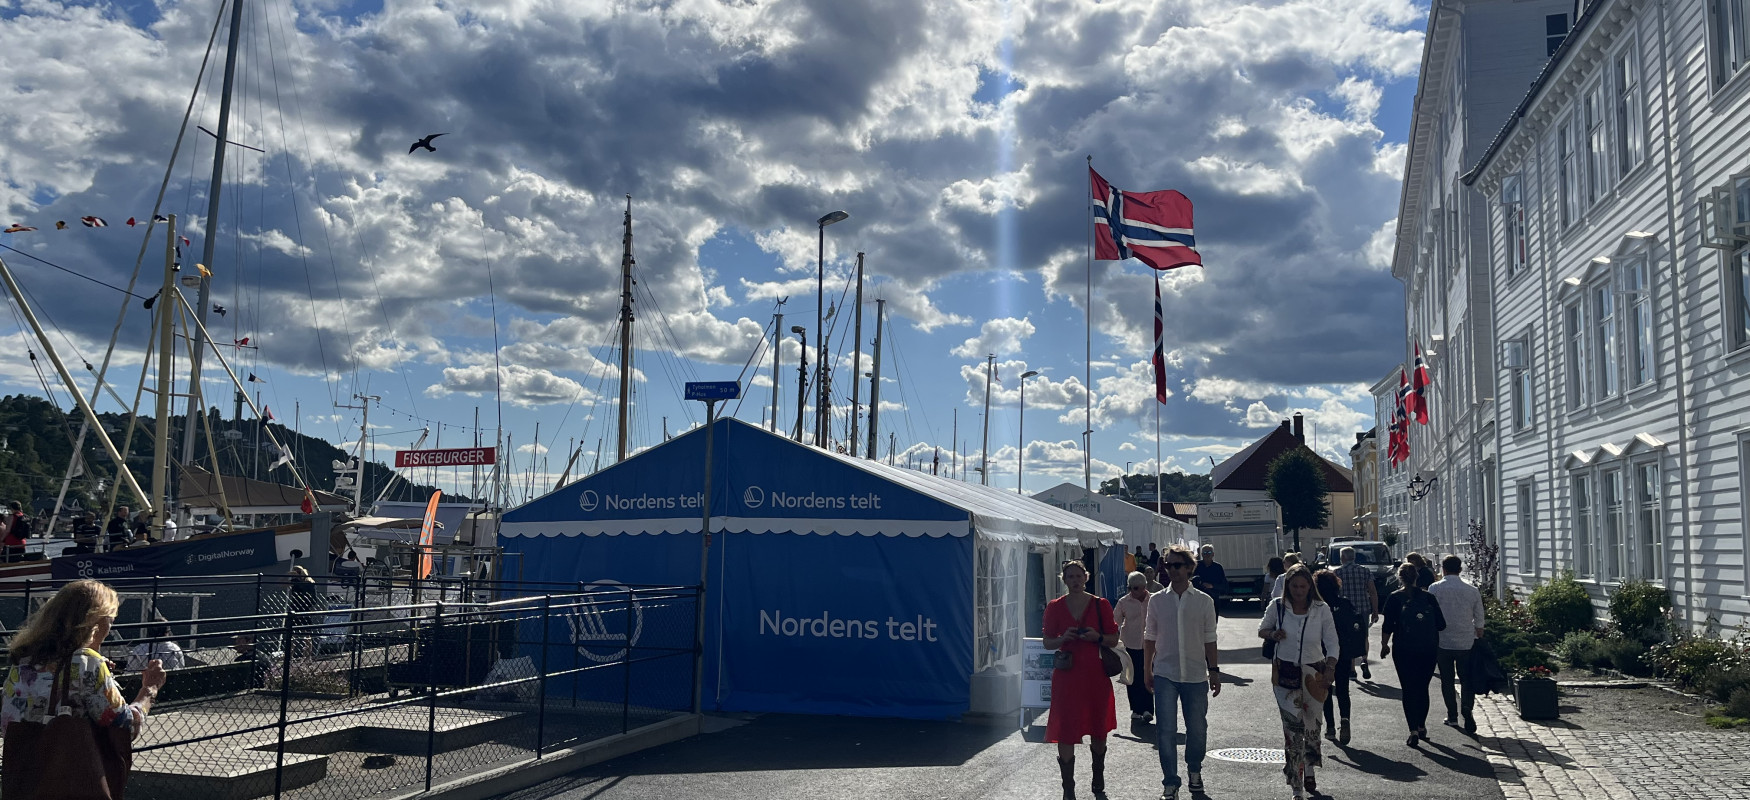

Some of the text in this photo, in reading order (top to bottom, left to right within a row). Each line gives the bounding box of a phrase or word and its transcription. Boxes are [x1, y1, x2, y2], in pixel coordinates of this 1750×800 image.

[403, 450, 485, 465] FISKEBURGER
[605, 492, 676, 511] Nordens
[771, 491, 882, 509] Nordens telt
[198, 548, 255, 562] DigitalNorway
[759, 609, 938, 642] Nordens telt
